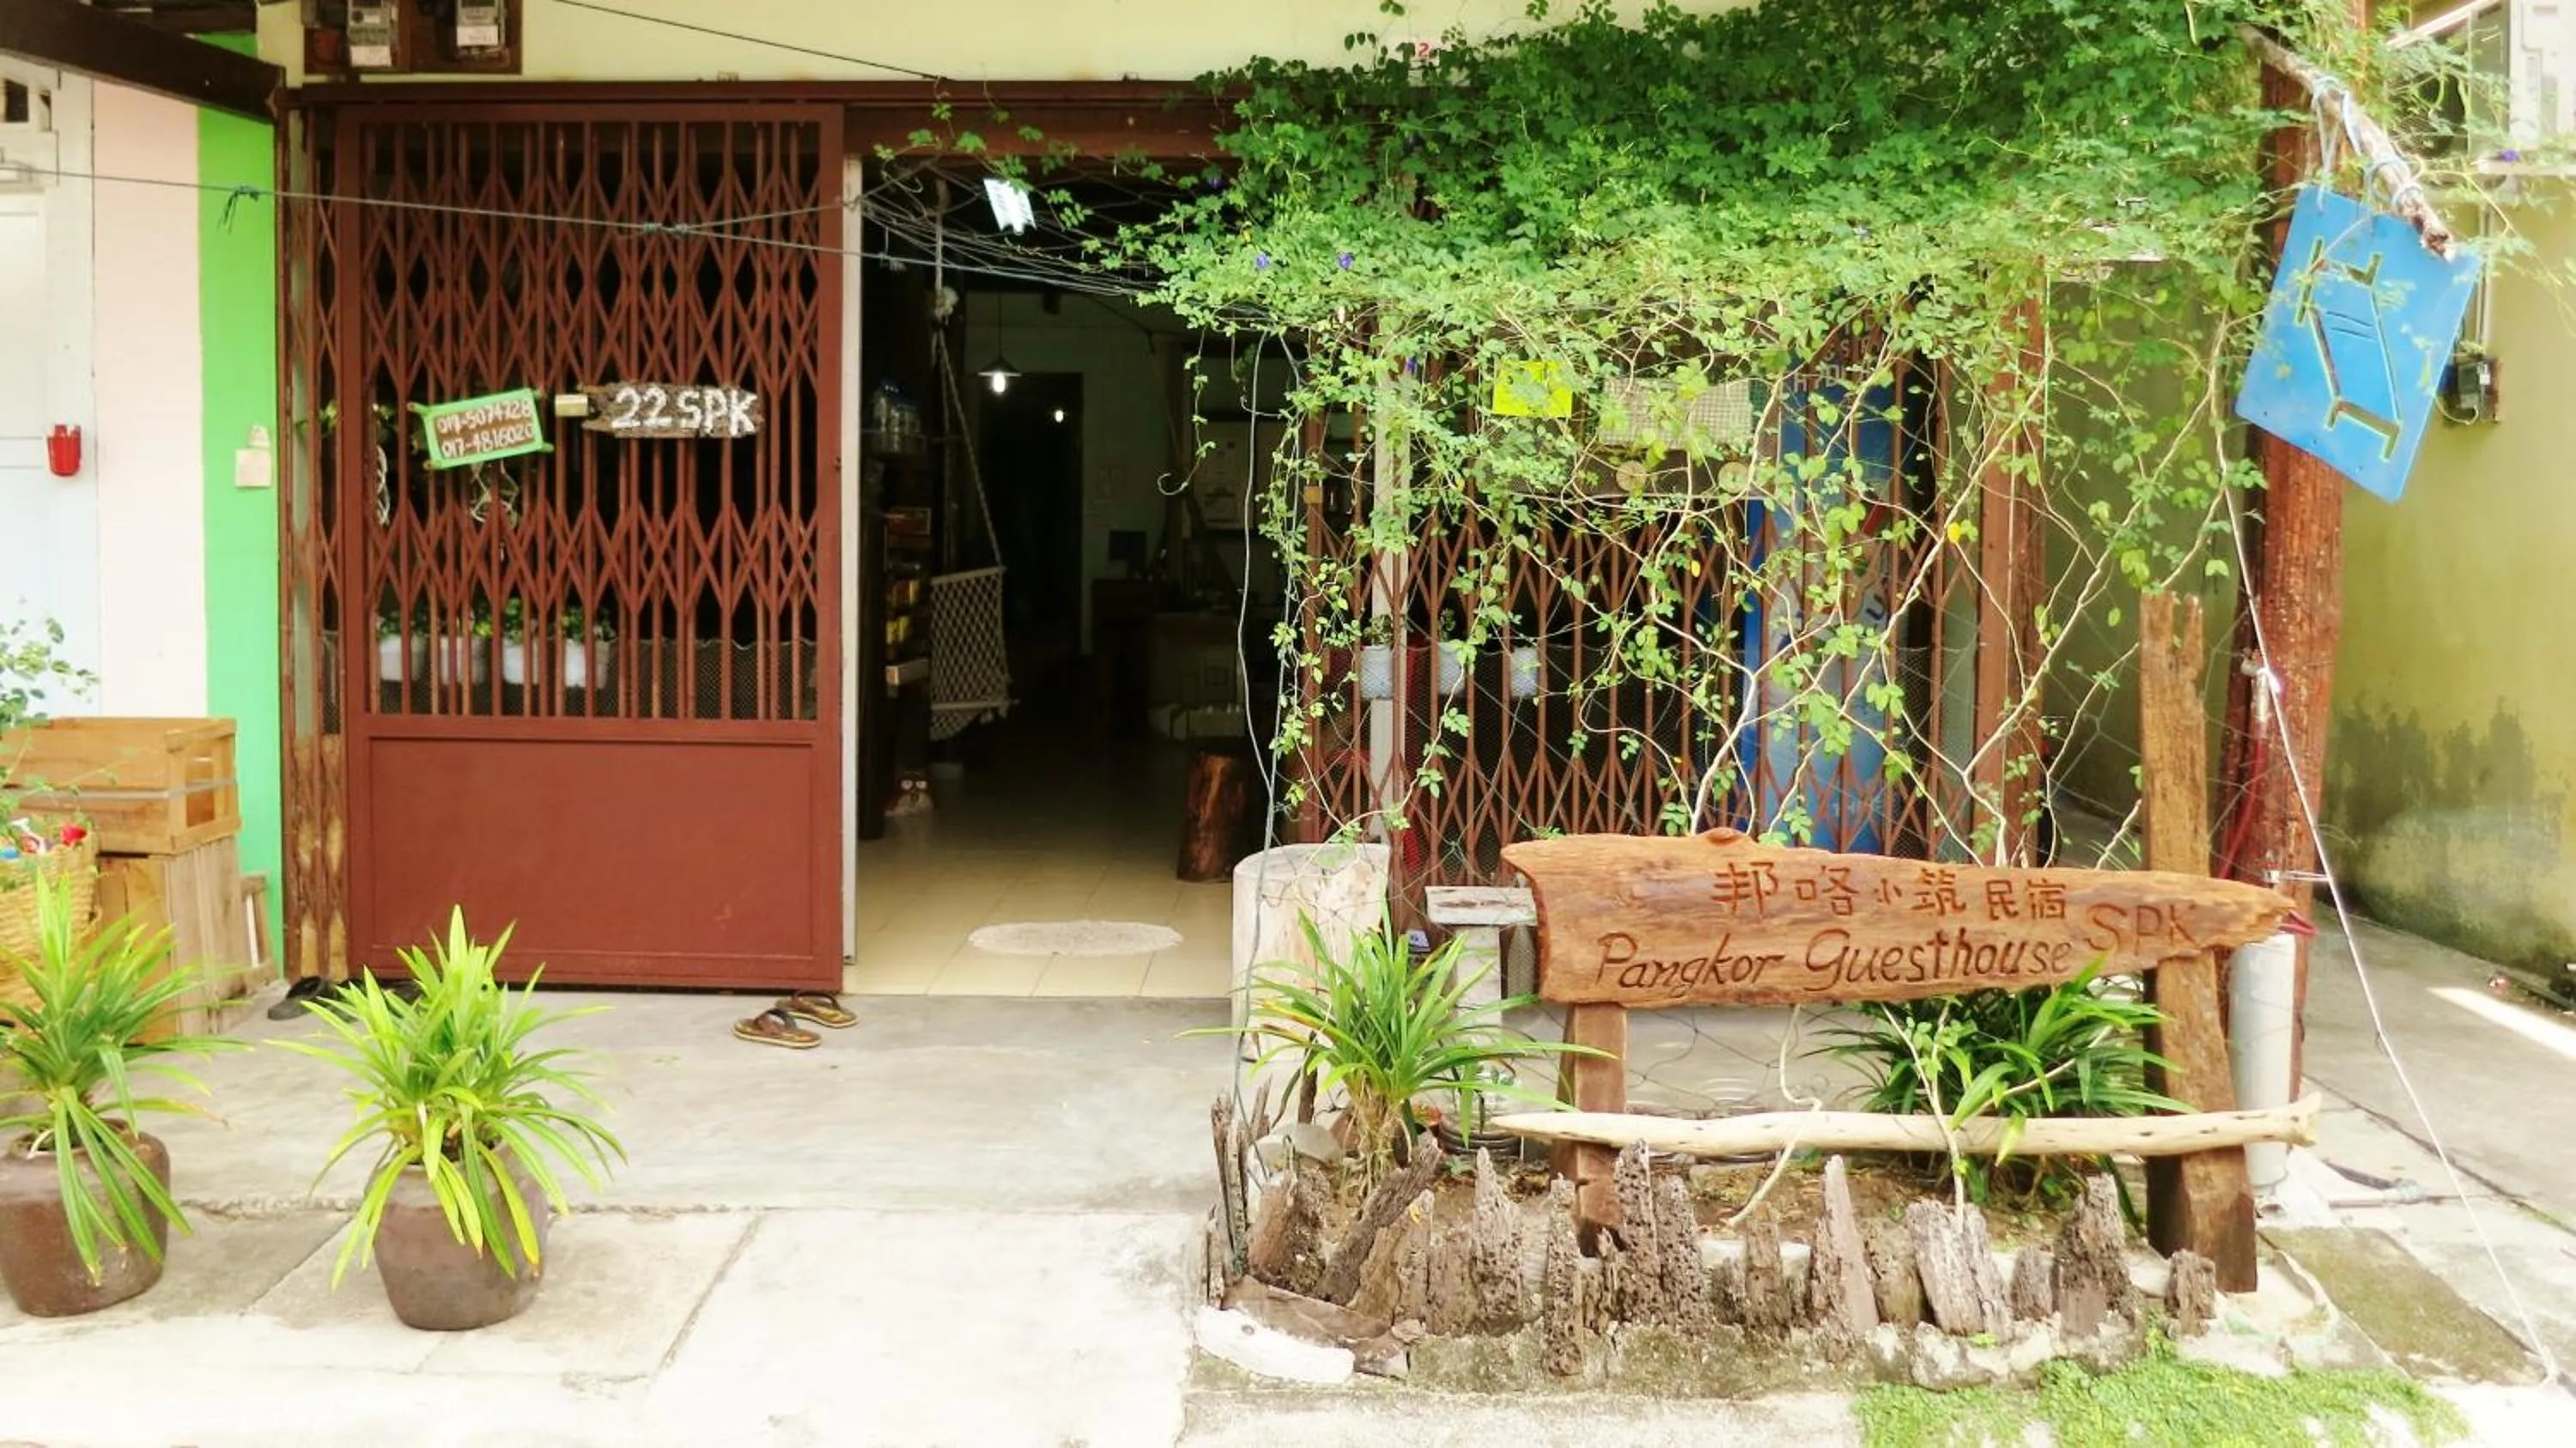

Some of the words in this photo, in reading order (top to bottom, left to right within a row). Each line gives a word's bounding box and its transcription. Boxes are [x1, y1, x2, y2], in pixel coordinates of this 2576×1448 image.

[611, 386, 672, 429] 22
[677, 388, 758, 437] SPK
[1595, 931, 1786, 999] Pangkor
[1803, 926, 2073, 992] Guesthouse
[2084, 903, 2200, 957] SPK
